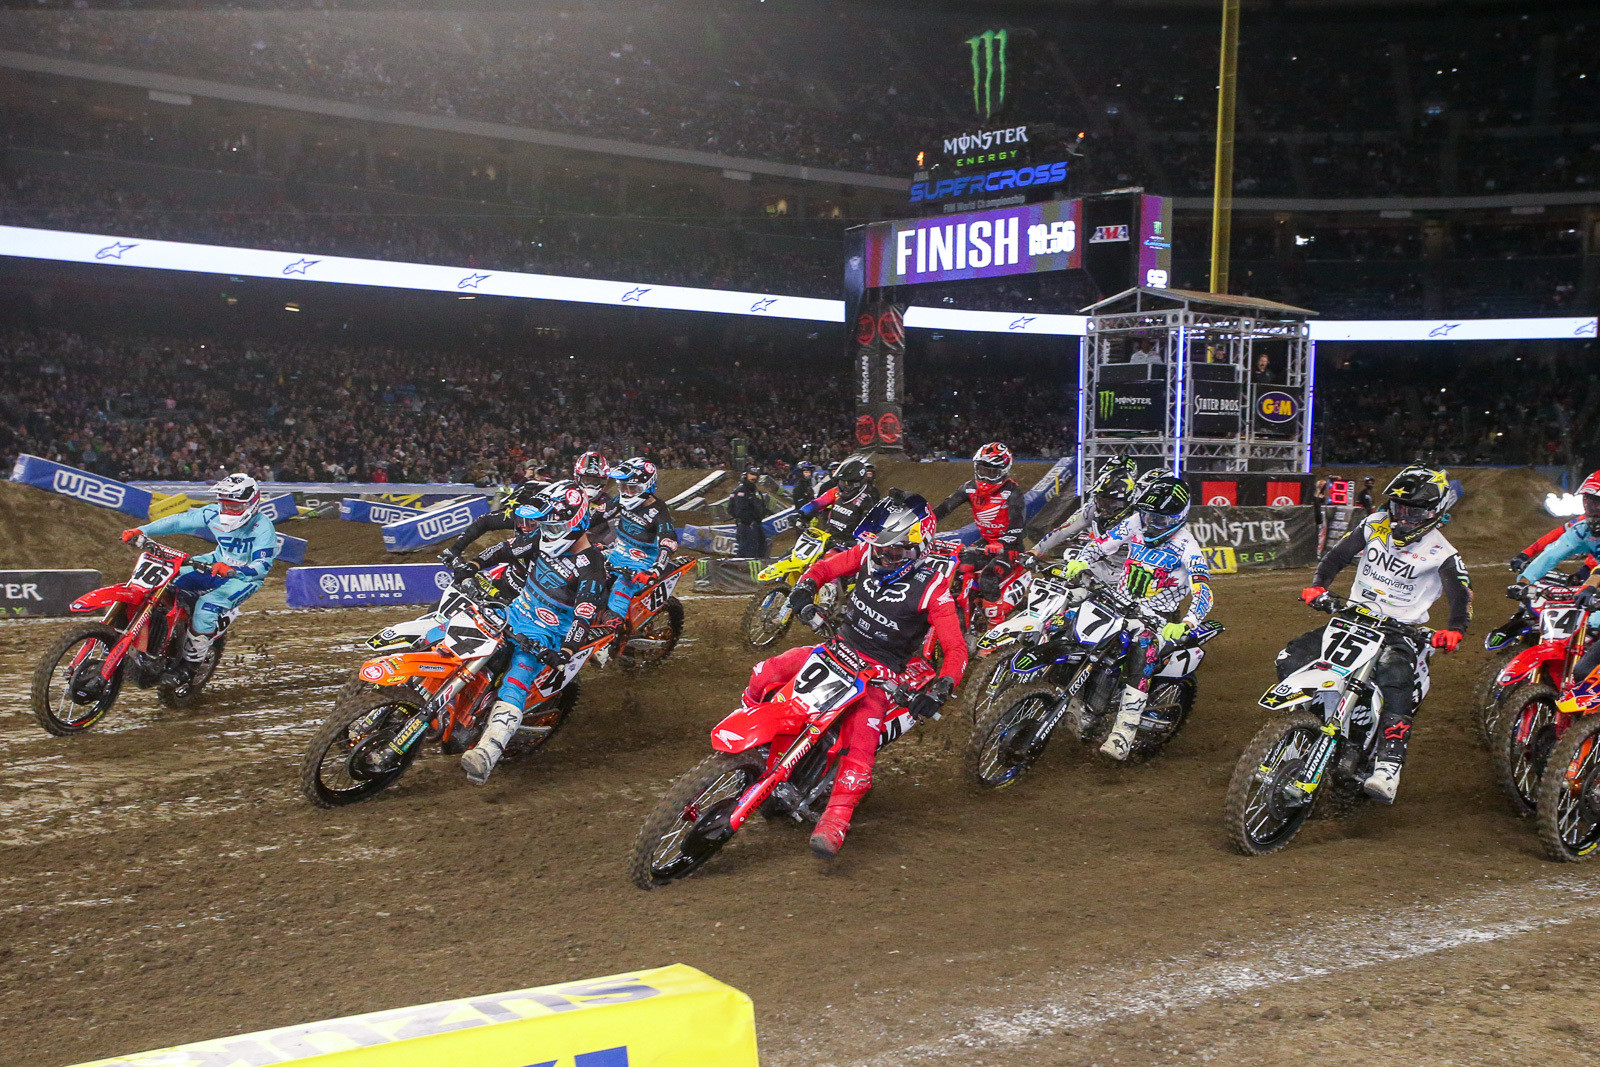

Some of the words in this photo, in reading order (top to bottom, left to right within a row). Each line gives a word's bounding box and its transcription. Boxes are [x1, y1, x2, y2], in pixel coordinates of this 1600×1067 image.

[943, 126, 1028, 155] MONSTER
[956, 150, 1018, 167] ENERGY
[908, 161, 1068, 202] SUPERCROSS
[896, 217, 1019, 275] FINISH
[1090, 225, 1129, 242] AMA
[1115, 397, 1152, 405] MONSTER
[1194, 395, 1219, 415] STATER
[53, 469, 126, 508] WPS
[417, 506, 474, 540] WPS
[833, 504, 853, 516] THOR
[976, 520, 1005, 529] HONDA
[338, 573, 406, 593] YAMAHA
[1370, 569, 1415, 592] Husqvarna
[329, 592, 404, 600] RACING
[850, 592, 900, 631] HONDA
[1082, 608, 1113, 636] 7
[446, 625, 490, 658] 4
[1324, 630, 1371, 668] 15
[1175, 649, 1191, 677] 7
[793, 662, 849, 712] 94
[396, 718, 422, 746] GALFER
[1040, 703, 1068, 741] DUNLOP
[1306, 735, 1330, 780] DUNLOP
[745, 779, 777, 815] DUNLOP
